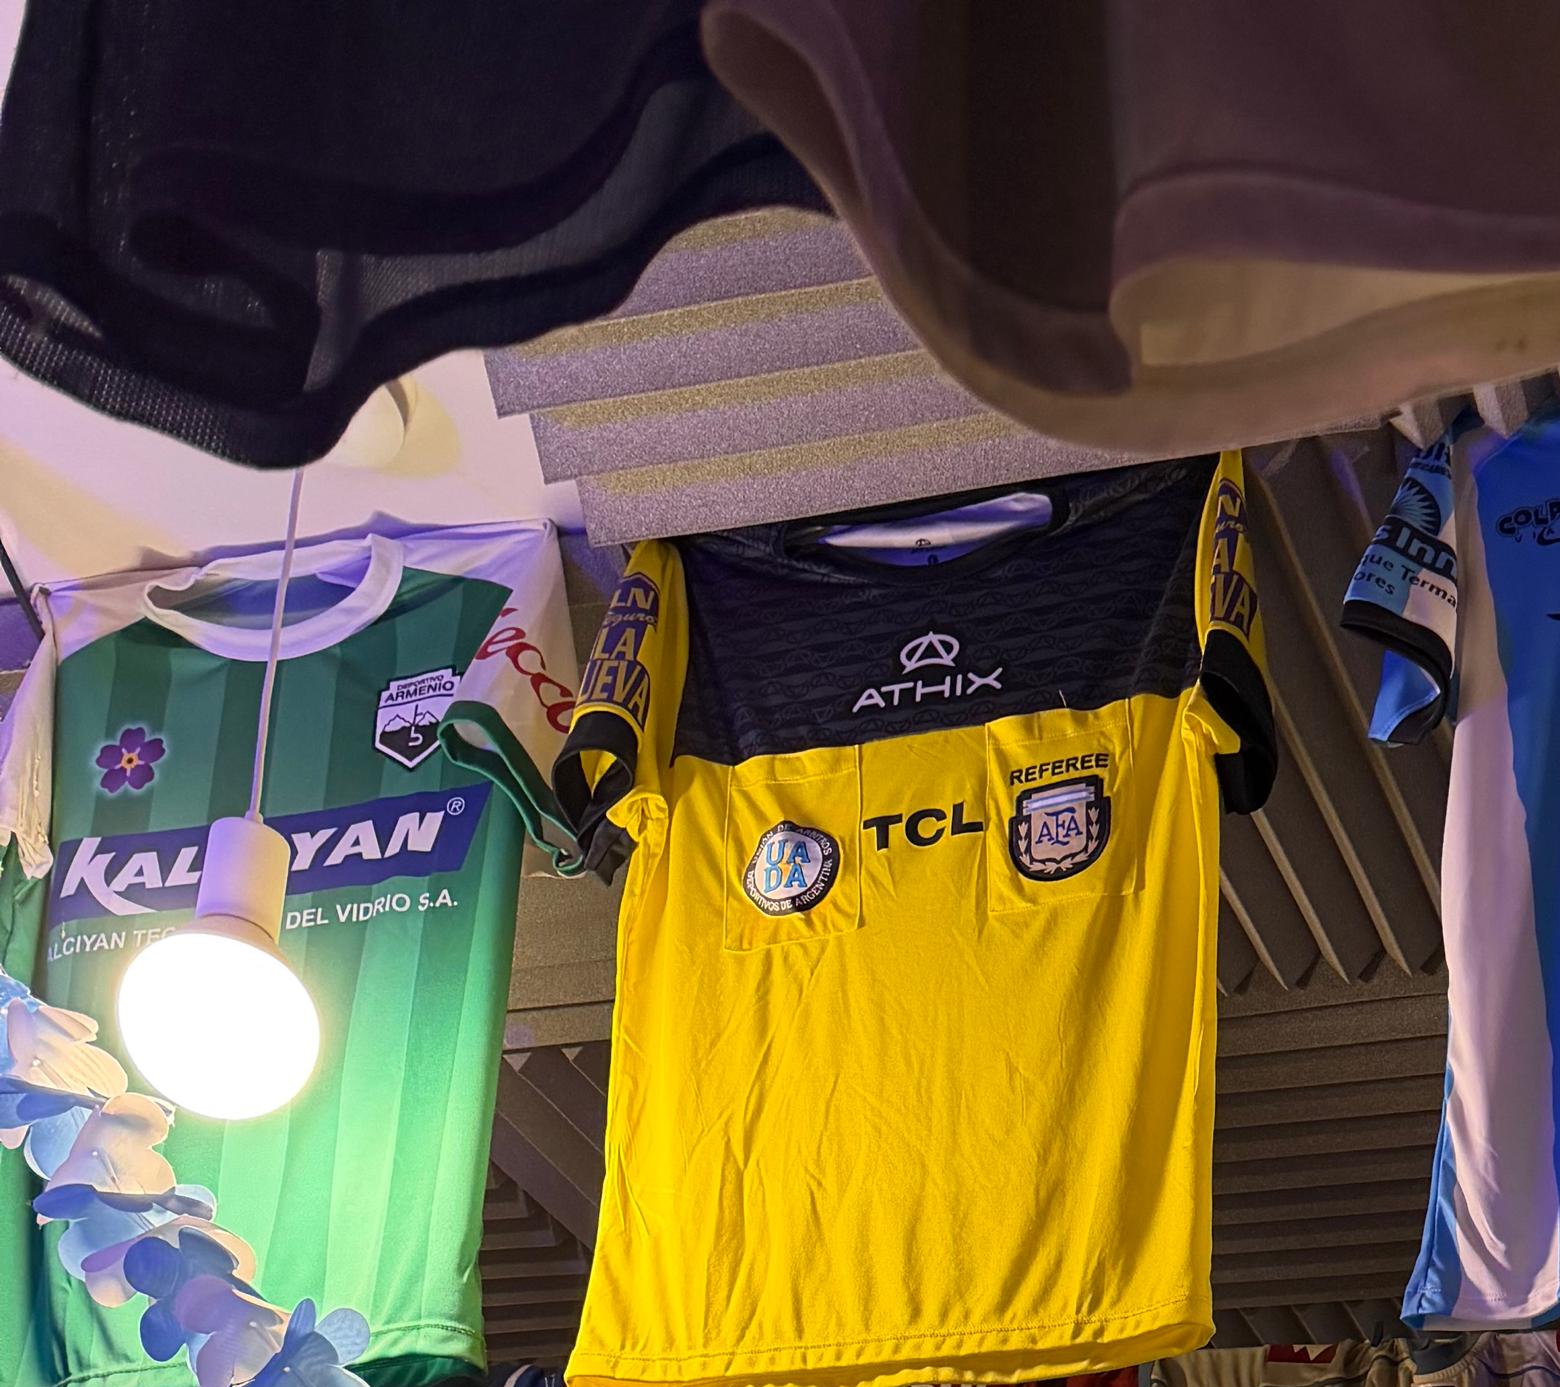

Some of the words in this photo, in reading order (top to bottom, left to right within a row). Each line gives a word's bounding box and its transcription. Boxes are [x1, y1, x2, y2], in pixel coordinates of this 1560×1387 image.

[384, 680, 455, 703] ARMENIO
[396, 674, 444, 691] DEPORTIVO
[852, 668, 1003, 712] ATHIX
[1009, 752, 1110, 787] REFEREE
[863, 800, 984, 852] TCL
[1036, 806, 1083, 848] AFA
[60, 811, 445, 916] KALYAN
[766, 838, 811, 867] UA
[763, 863, 808, 893] DA
[47, 932, 126, 962] ALCIYAN
[285, 908, 329, 931] DEL
[336, 893, 411, 924] VIDRIO
[417, 888, 459, 911] S.A.
